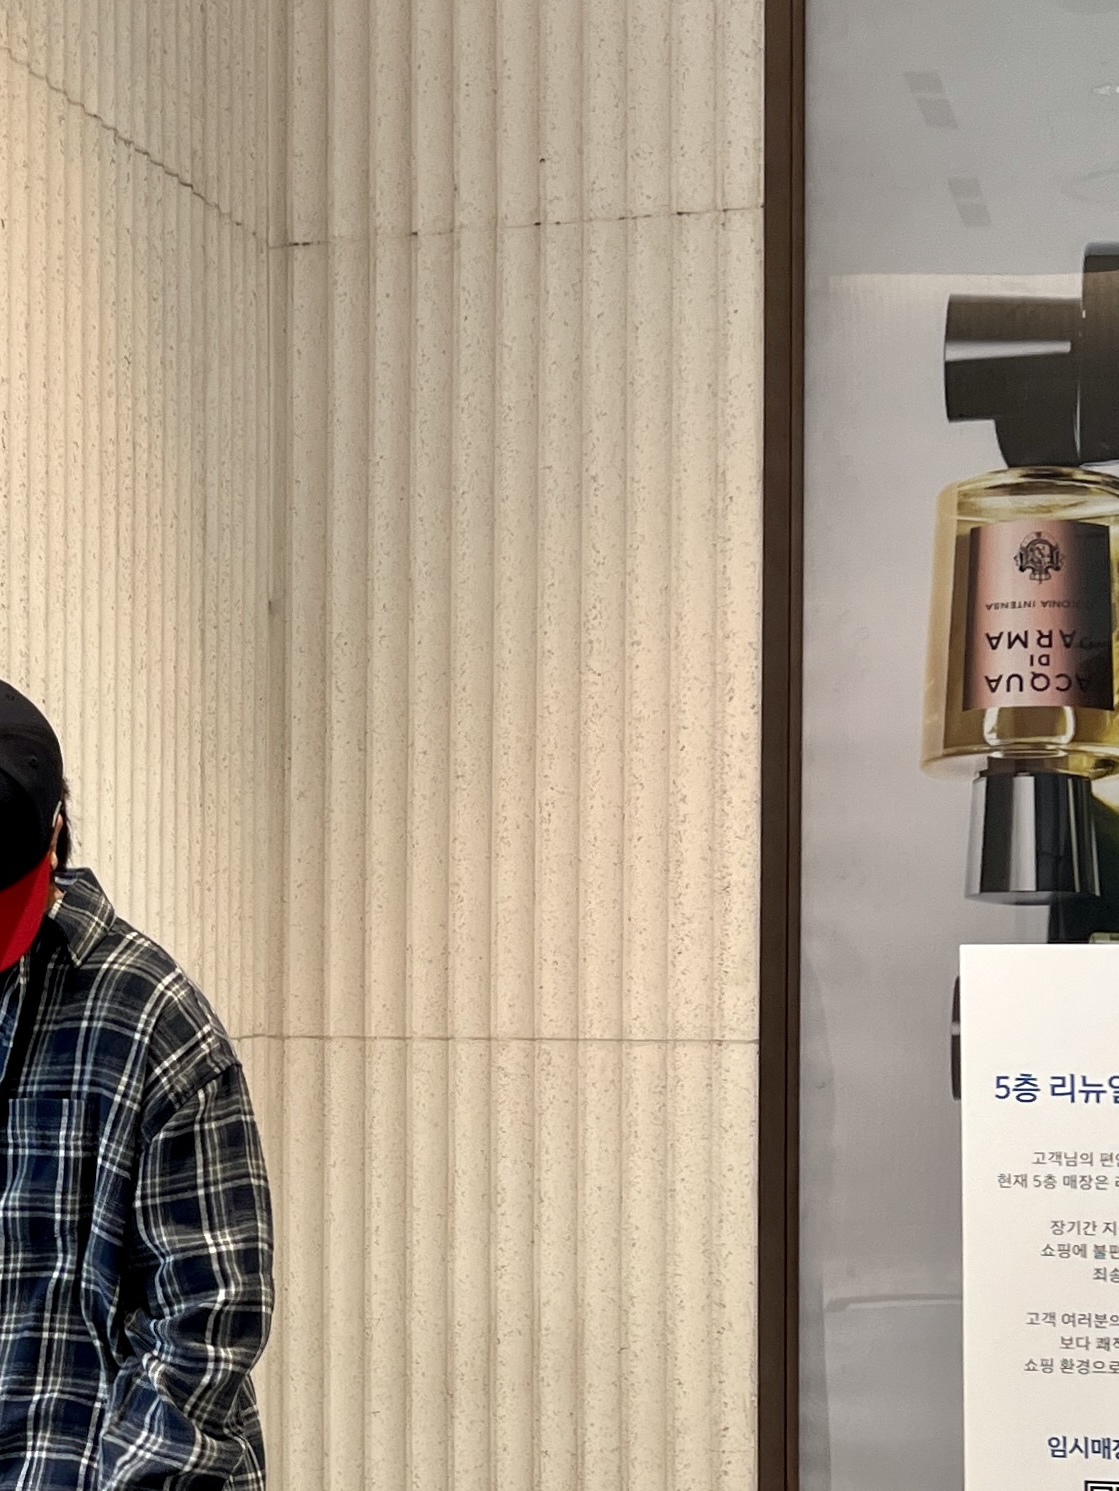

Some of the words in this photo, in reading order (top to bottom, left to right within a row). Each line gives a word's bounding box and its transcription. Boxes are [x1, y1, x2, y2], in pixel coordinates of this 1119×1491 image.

[985, 600, 1036, 611] INTENSA
[1040, 599, 1079, 610] ONIA
[1029, 654, 1050, 667] DI
[984, 671, 1091, 694] ACQUA
[994, 1073, 1042, 1104] 5층
[1032, 1151, 1094, 1168] 고객님의
[997, 1173, 1028, 1190] 현재
[1033, 1174, 1057, 1190] 5층
[1063, 1174, 1110, 1191] 매장은
[1050, 1220, 1098, 1236] 장기간
[1102, 1221, 1119, 1237] 지
[1040, 1243, 1088, 1260] 쇼핑에
[1025, 1312, 1056, 1328] 고객
[1059, 1336, 1091, 1352] 보다
[1024, 1358, 1054, 1374] 쇼핑
